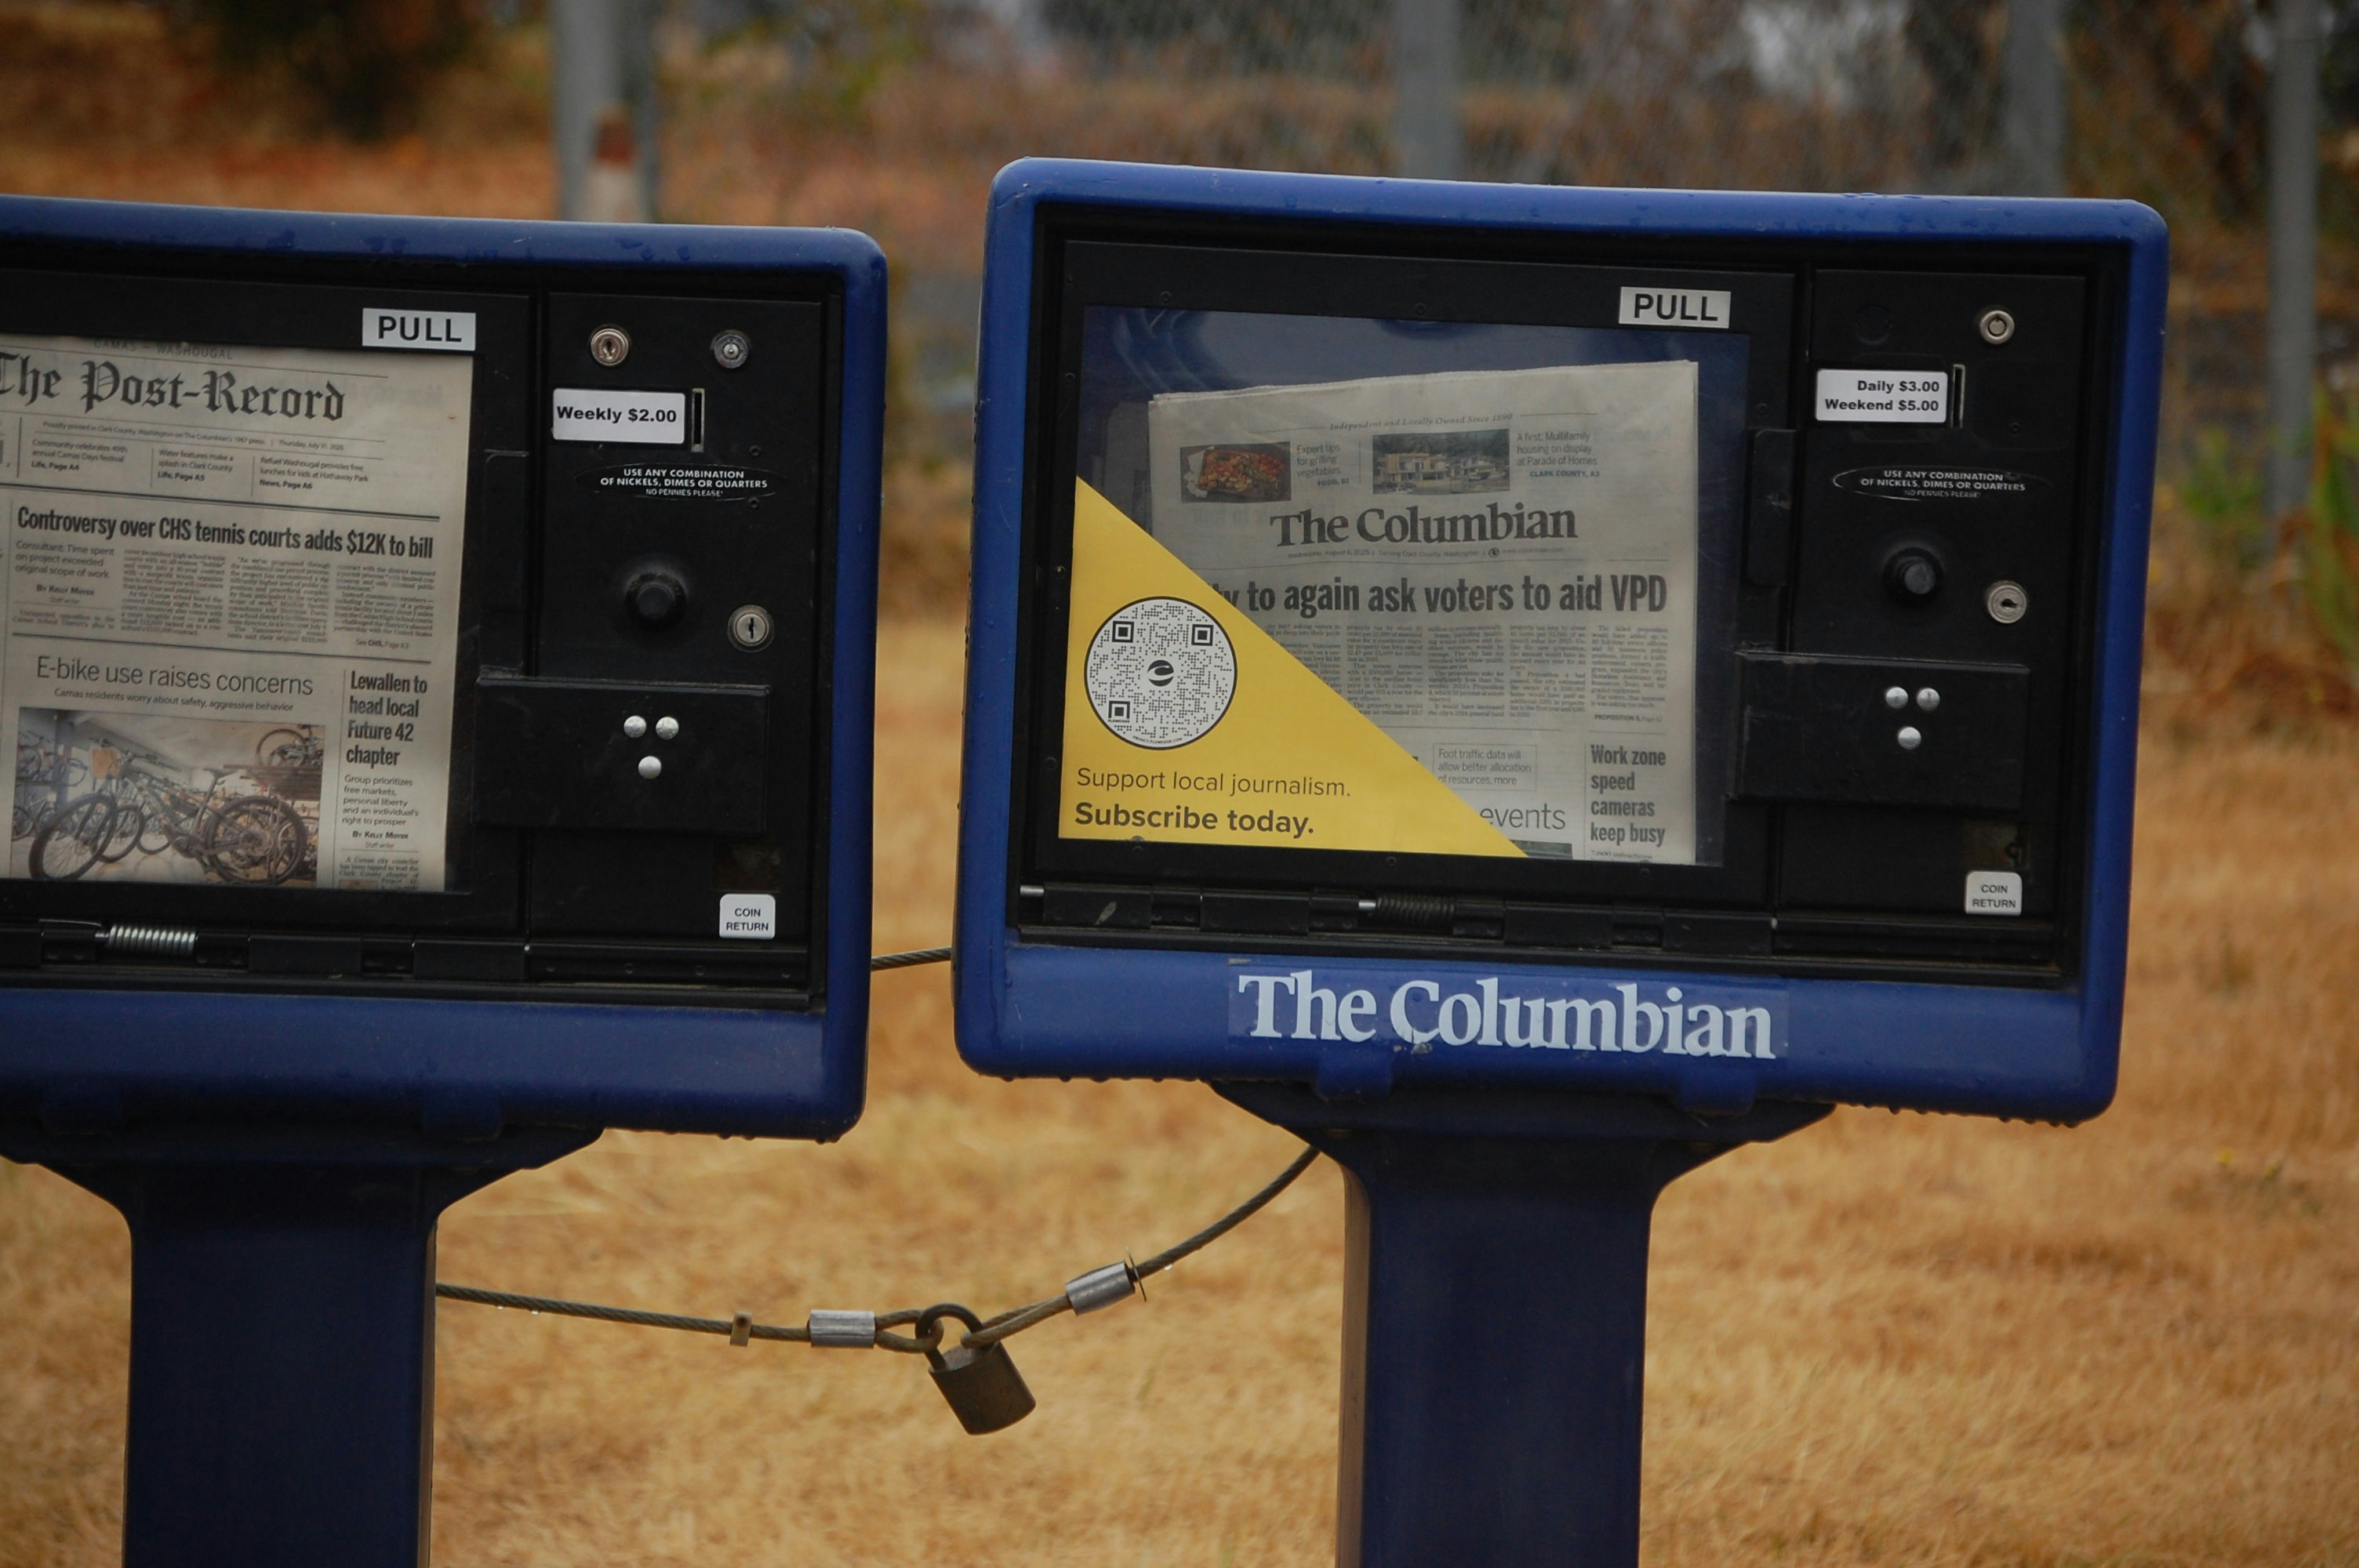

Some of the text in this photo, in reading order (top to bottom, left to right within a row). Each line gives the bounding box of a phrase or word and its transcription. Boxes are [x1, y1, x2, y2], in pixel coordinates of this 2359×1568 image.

[1634, 293, 1718, 321] PULL
[378, 315, 463, 343] PULL
[156, 343, 233, 360] WASHOUGAL
[80, 361, 345, 421] Post-Record
[1857, 380, 1939, 394] Daily $3.00
[1825, 398, 1939, 412] Weekend $5.00
[557, 405, 677, 424] Weekly $2.00
[1329, 420, 1382, 431] Independent
[1383, 418, 1400, 426] and
[1434, 416, 1465, 424] Owned
[1492, 412, 1513, 422] 1890
[1517, 432, 1523, 442] A
[1545, 430, 1590, 443] Multifamily
[1296, 443, 1340, 455] Expert tips
[1516, 444, 1592, 457] housing on display
[49, 462, 67, 470] Page
[1296, 455, 1336, 466] for grilling
[1516, 456, 1598, 466] at Parade of Homes
[174, 472, 193, 481] Page
[645, 469, 667, 478] ANY
[670, 469, 743, 478] COMBINATION
[1296, 466, 1341, 478] vegetables
[1928, 471, 2003, 481] COMBINATION
[282, 481, 301, 490] Page
[600, 477, 614, 485] OF
[616, 477, 661, 487] NICKELS,
[664, 478, 695, 487] DIMES
[1923, 480, 1954, 488] DIMES
[1973, 481, 2025, 491] QUARTERS
[1270, 502, 1579, 546] The Columbian
[17, 506, 433, 558] Controversy over CHS tennis courts adds $12K to bill
[67, 543, 89, 554] Time
[90, 547, 114, 557] spent
[15, 554, 104, 567] on project exceeded
[15, 564, 48, 575] original
[49, 568, 75, 577] scope
[76, 568, 86, 576] of
[1247, 581, 1276, 611] to
[1283, 579, 1359, 618] again
[1368, 577, 1416, 612] ask
[1423, 578, 1514, 613] voters
[1521, 575, 1550, 611] to
[1559, 575, 1602, 611] aid
[1610, 574, 1667, 612] VPD
[37, 655, 314, 695] E-bike use raises concerns
[351, 670, 427, 694] Lewallen to
[54, 688, 293, 711] Camas residents worry about safety, aggressive behavior
[349, 695, 420, 717] head local
[347, 720, 414, 742] Future 42
[346, 744, 401, 769] chapter
[1438, 748, 1521, 760] Foot traffic data will
[1590, 744, 1666, 766] Work zone
[1438, 761, 1531, 772] allow better allocation
[344, 774, 413, 786] Group prioritizes
[1077, 767, 1350, 797] Support local journalism.
[1493, 776, 1517, 785] more
[1590, 771, 1635, 794] speed
[343, 785, 397, 797] free markets,
[380, 797, 408, 808] liberty
[1590, 800, 1656, 817] cameras
[342, 817, 362, 826] right
[1074, 801, 1314, 839] Subscribe today.
[1590, 822, 1666, 848] keep busy
[734, 908, 761, 917] COIN
[726, 922, 769, 931] RETURN
[1238, 969, 1776, 1058] The Columbian
